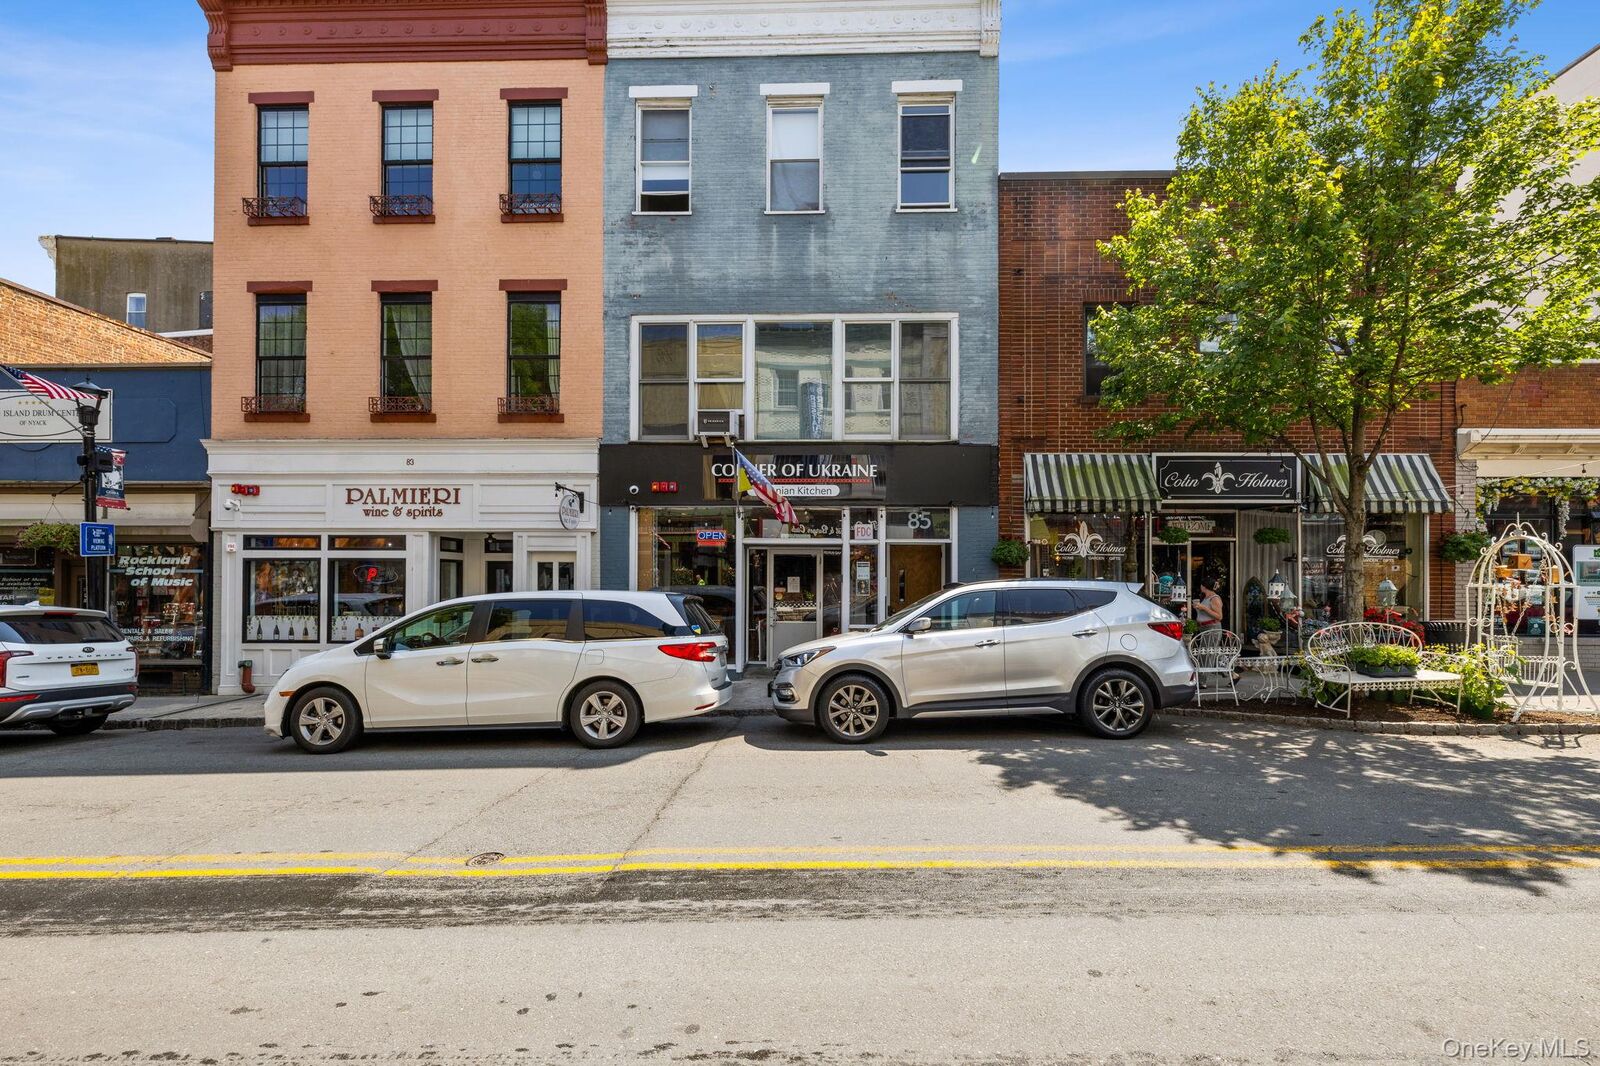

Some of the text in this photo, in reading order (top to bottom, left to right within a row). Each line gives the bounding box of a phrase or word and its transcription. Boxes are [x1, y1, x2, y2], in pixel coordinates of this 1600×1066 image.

[406, 458, 415, 466] 83
[711, 463, 878, 478] COER OF UKRAINE
[1164, 471, 1289, 488] Colin Holmes
[344, 486, 462, 506] PALMIERI
[797, 486, 832, 496] Kitchen
[362, 506, 444, 519] wine & spirits
[907, 511, 932, 530] 85
[697, 531, 726, 540] OPEN
[856, 527, 871, 537] FDC
[1054, 541, 1126, 553] Colin Holmes
[1364, 544, 1400, 555] Holmes
[118, 555, 192, 565] Rockland
[124, 566, 176, 576] School
[130, 577, 194, 586] of Music
